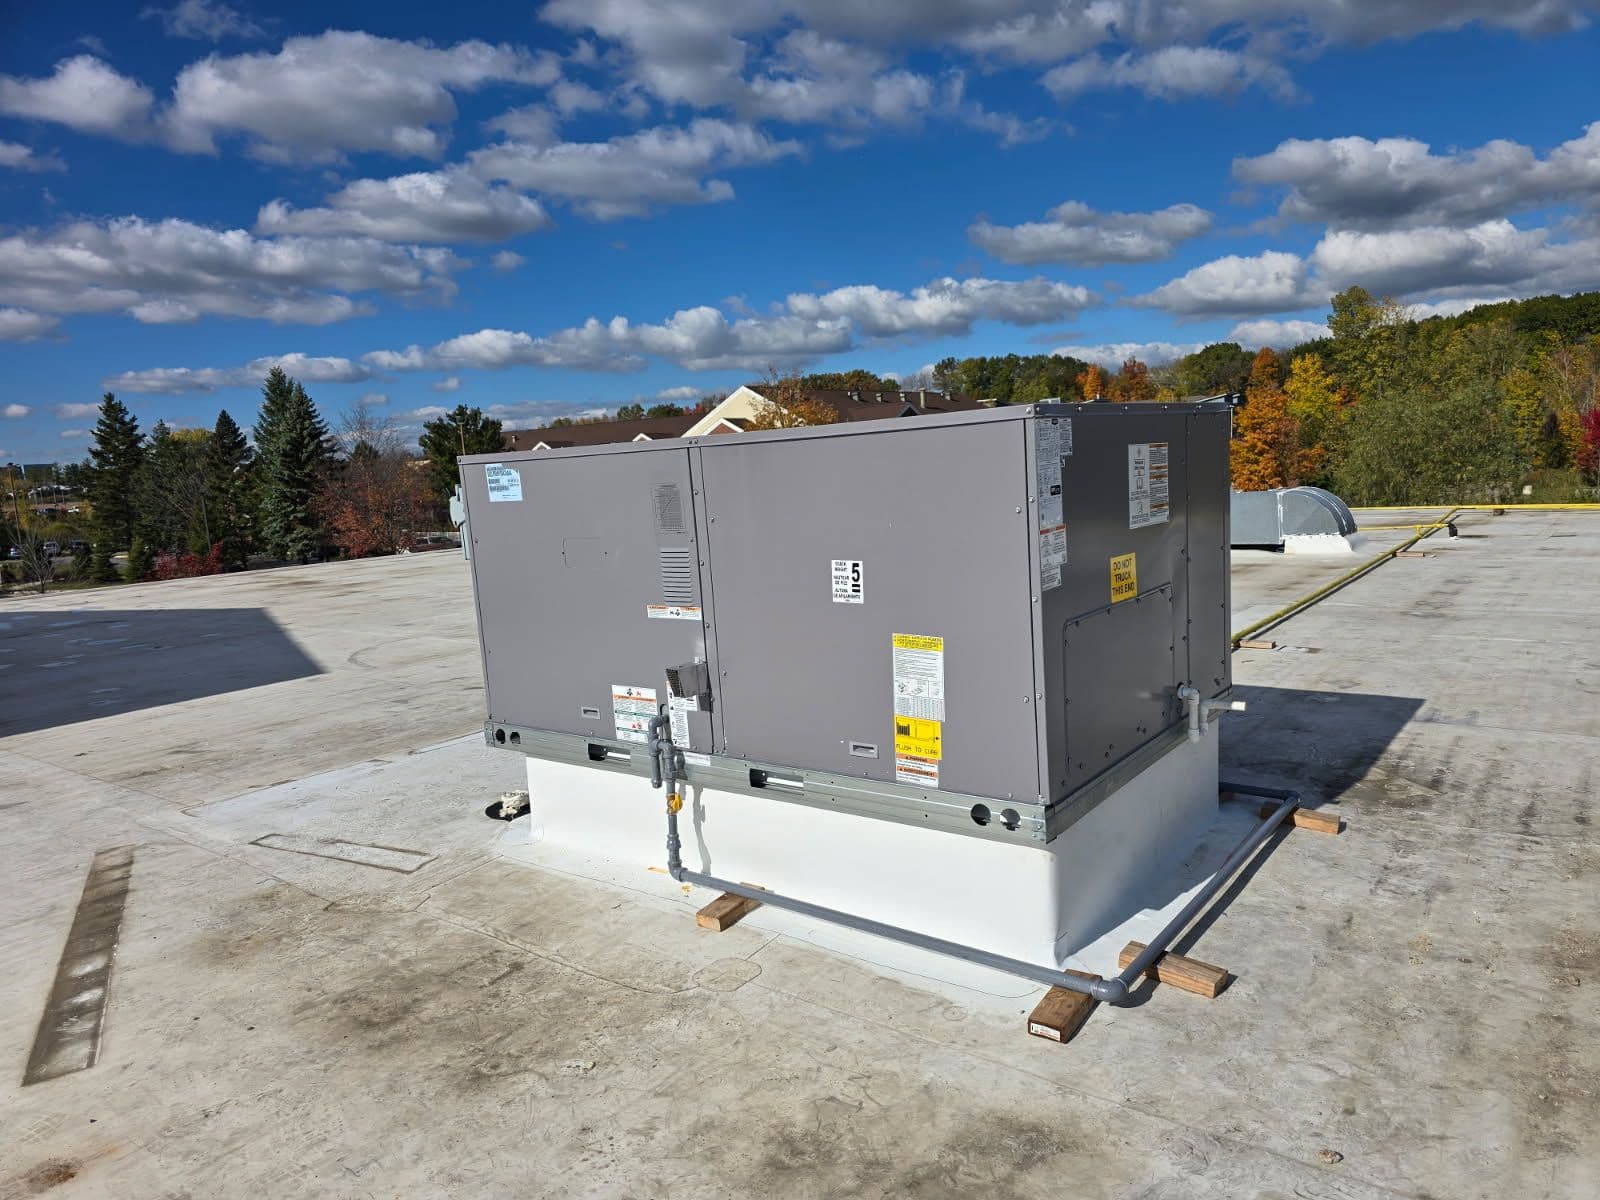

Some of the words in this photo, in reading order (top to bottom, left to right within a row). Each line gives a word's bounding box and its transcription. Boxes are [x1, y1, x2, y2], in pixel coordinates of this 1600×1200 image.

[1114, 561, 1121, 571] DO
[1121, 558, 1132, 568] NOT
[852, 562, 860, 582] 5
[1114, 570, 1132, 584] TRUCK
[1112, 584, 1123, 595] THIS
[1124, 582, 1134, 593] END
